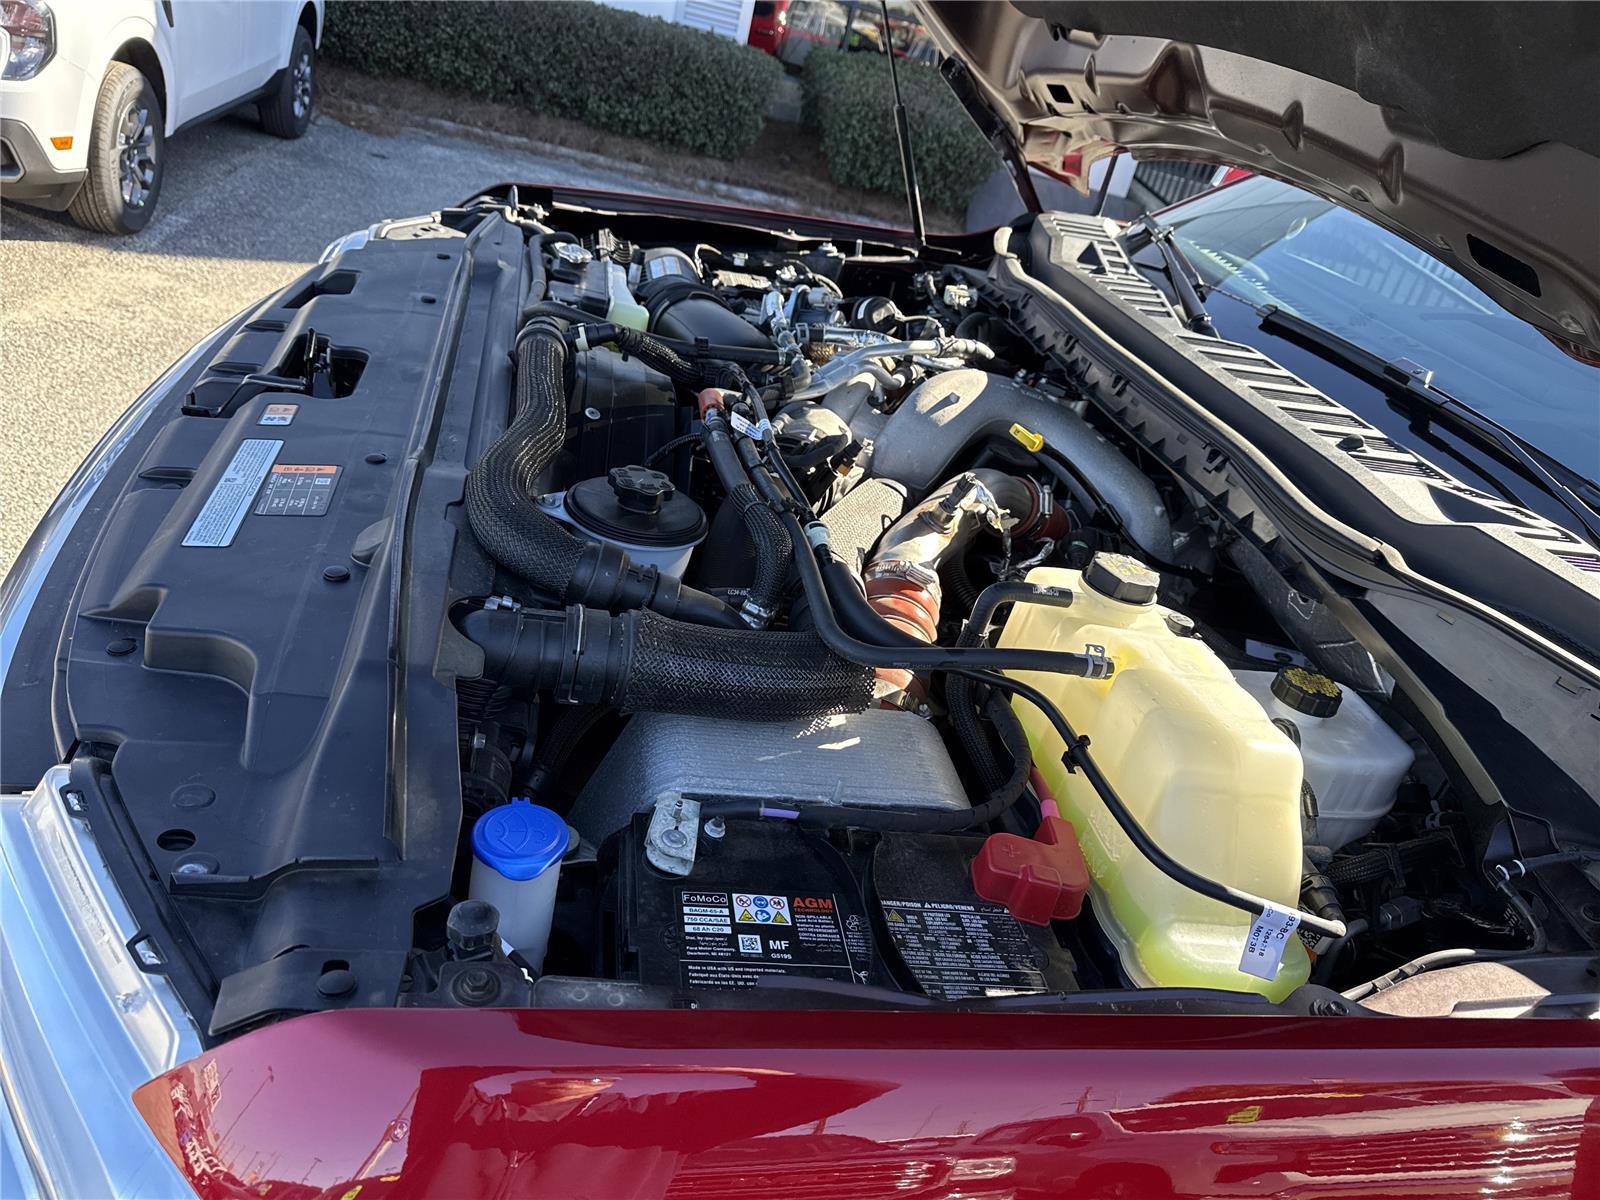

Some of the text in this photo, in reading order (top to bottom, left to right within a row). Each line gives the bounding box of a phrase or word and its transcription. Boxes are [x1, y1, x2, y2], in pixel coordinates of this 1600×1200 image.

[684, 894, 726, 902] FoMoCo
[793, 897, 832, 908] AGM
[769, 940, 789, 950] MF
